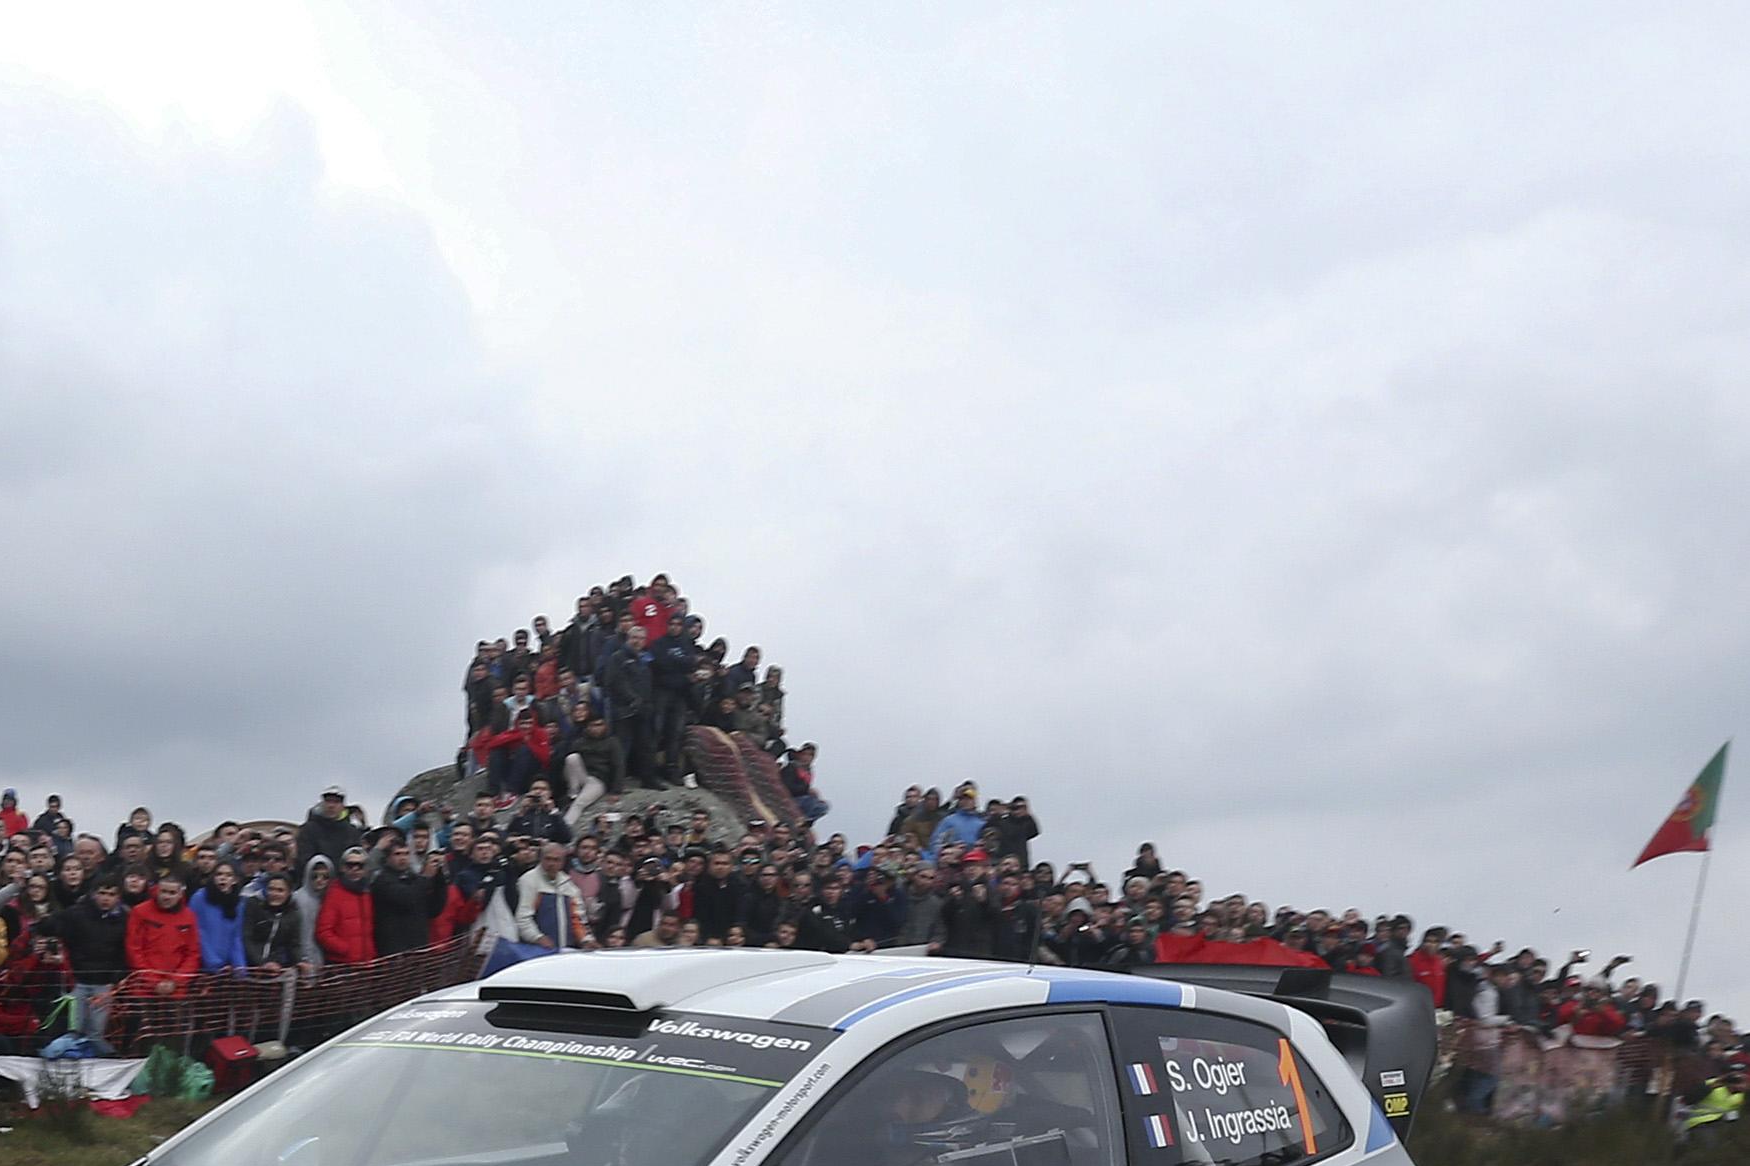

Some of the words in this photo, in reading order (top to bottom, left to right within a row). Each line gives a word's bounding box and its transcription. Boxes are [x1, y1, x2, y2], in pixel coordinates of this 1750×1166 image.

[644, 604, 658, 617] 2
[413, 1032, 464, 1044] World
[456, 1032, 502, 1048] Rally
[502, 1035, 638, 1062] Championship
[647, 1018, 812, 1052] Volkswagen
[1165, 1060, 1193, 1093] S.
[1193, 1056, 1247, 1096] Ogier
[1278, 1038, 1318, 1155] 1
[1186, 1110, 1206, 1143] J.
[1205, 1099, 1292, 1145] Ingrassia
